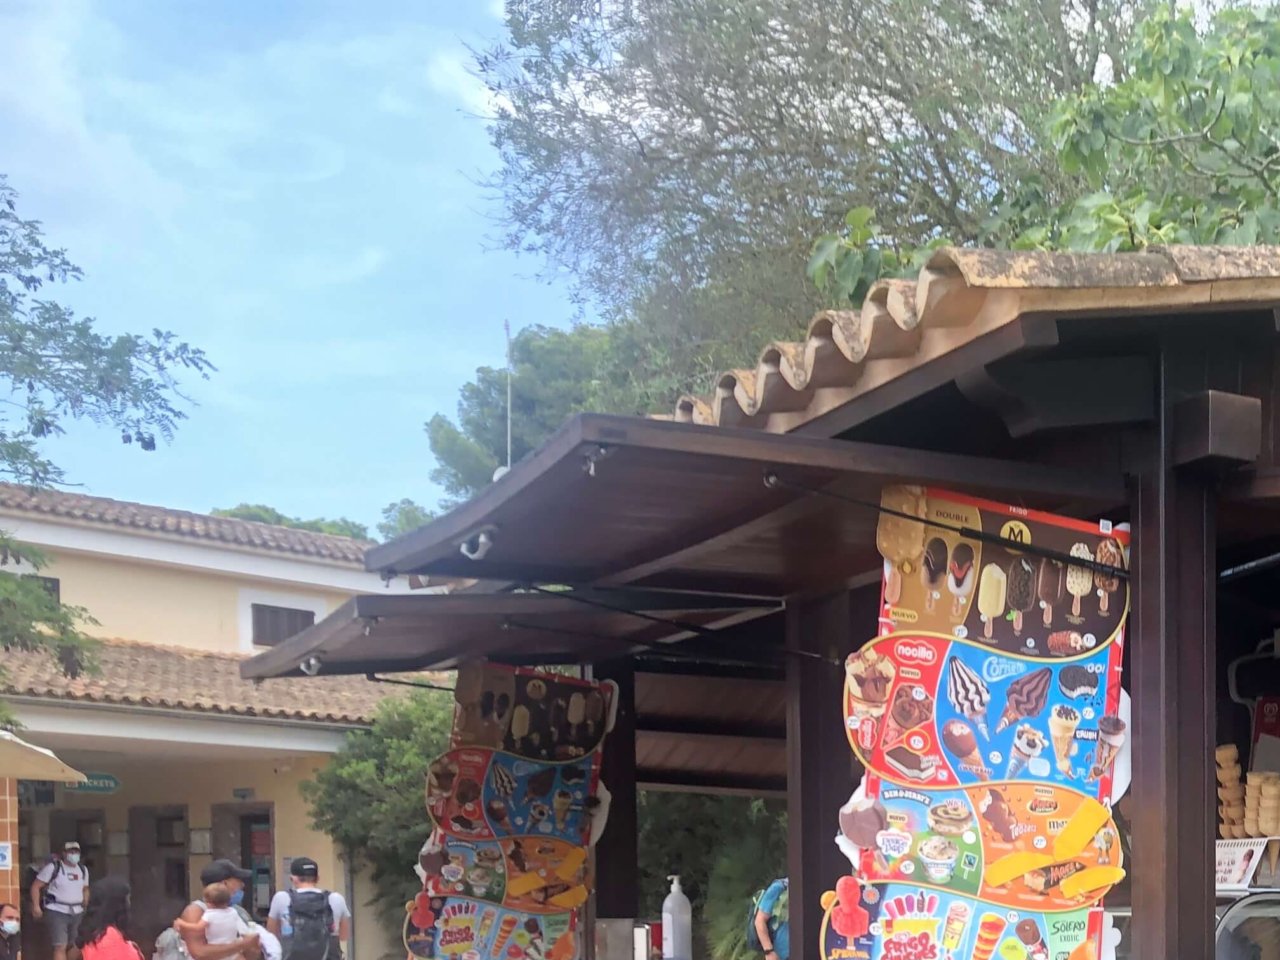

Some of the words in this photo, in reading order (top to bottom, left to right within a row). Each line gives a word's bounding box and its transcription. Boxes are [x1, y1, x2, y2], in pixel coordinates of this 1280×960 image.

[935, 510, 969, 523] DOUBLE
[1009, 506, 1028, 516] FRIGO
[891, 610, 917, 619] NUEVO
[897, 645, 934, 659] nocilla
[1051, 920, 1086, 935] SOLERO
[884, 932, 929, 954] FRIGO
[1059, 934, 1080, 942] EXOTIC
